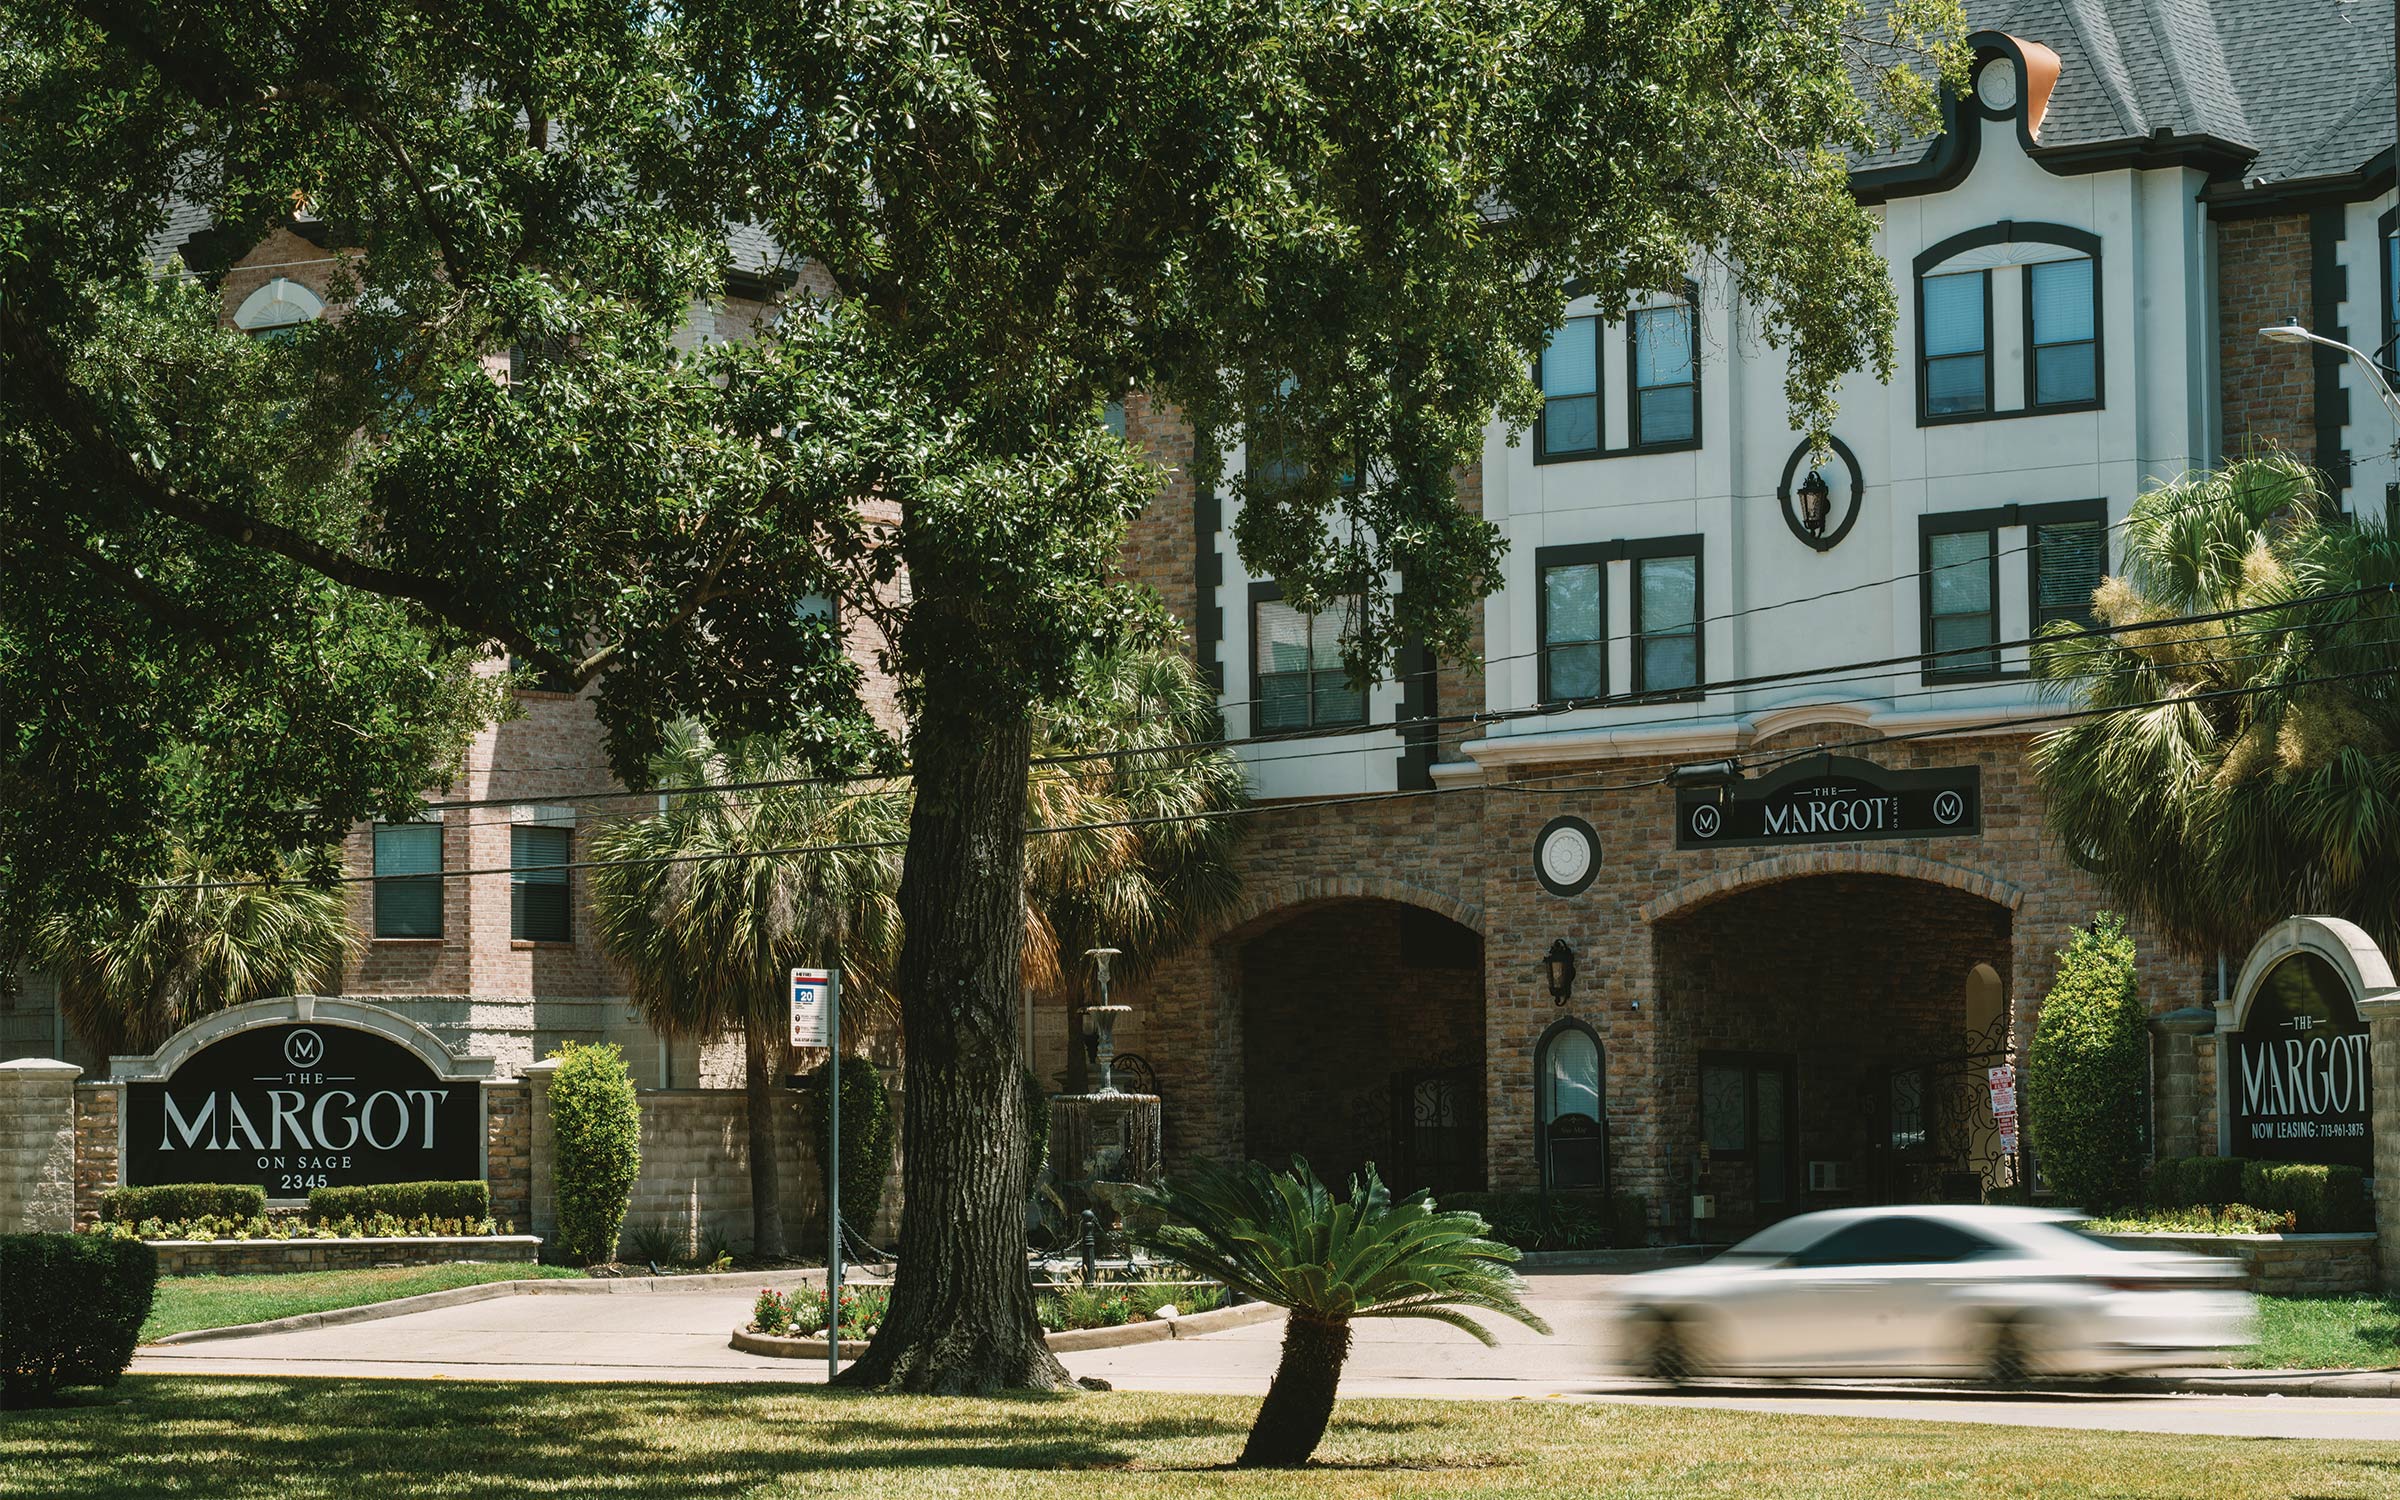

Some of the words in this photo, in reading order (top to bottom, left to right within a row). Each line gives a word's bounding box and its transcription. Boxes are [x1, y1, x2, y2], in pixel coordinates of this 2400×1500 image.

[1813, 787, 1837, 797] THE
[1763, 797, 1889, 835] MARGOT
[800, 991, 813, 1001] 20
[2293, 1015, 2313, 1030] THE
[286, 1072, 323, 1085] THE
[2241, 1034, 2370, 1116] MARGOT
[158, 1090, 449, 1150] MARGOT
[2252, 1123, 2274, 1139] NOW
[2277, 1121, 2319, 1138] LEASING:
[2320, 1122, 2364, 1137] 713-961-3875
[257, 1156, 285, 1170] ON
[297, 1156, 352, 1169] SAGE
[281, 1174, 328, 1190] 2345
